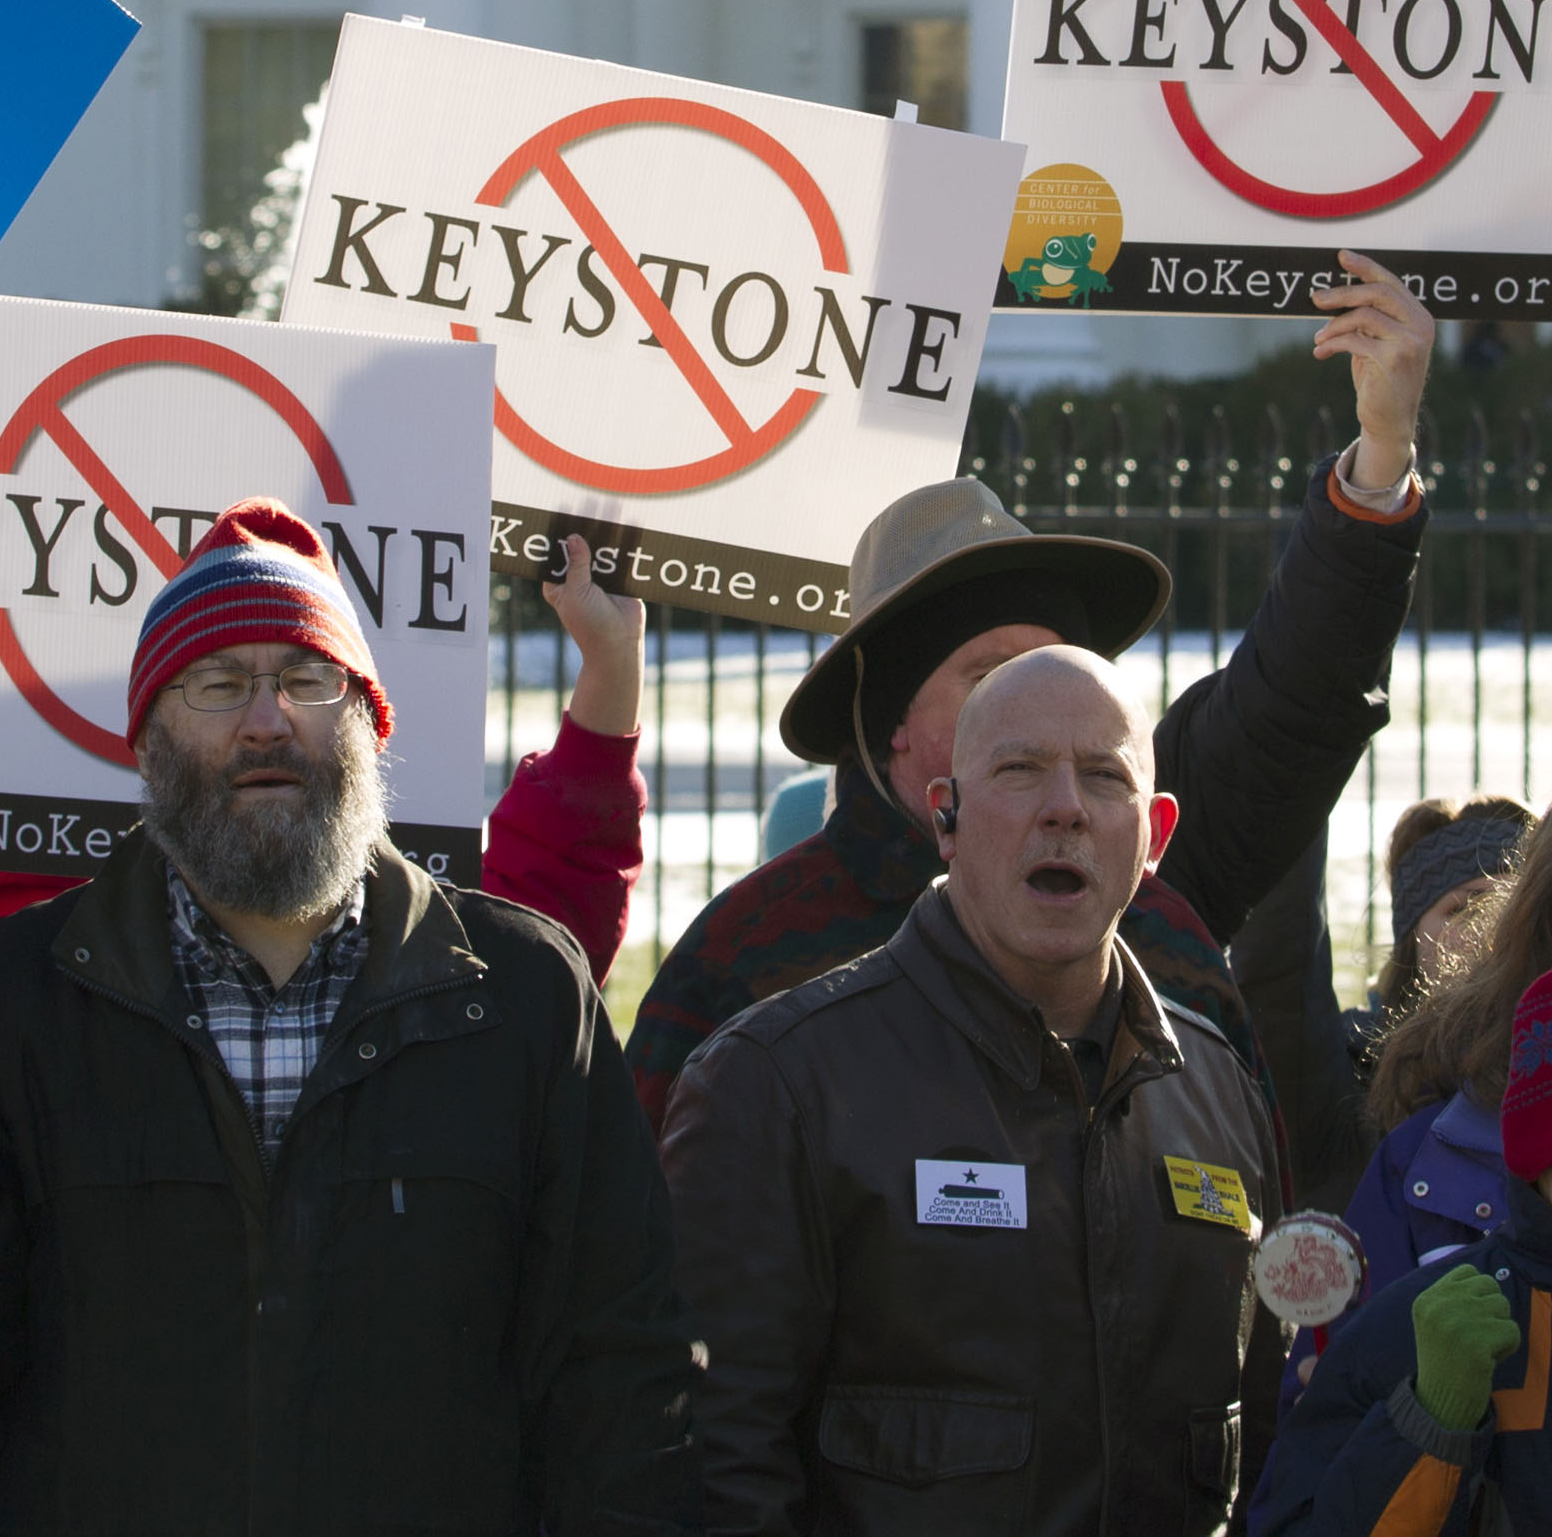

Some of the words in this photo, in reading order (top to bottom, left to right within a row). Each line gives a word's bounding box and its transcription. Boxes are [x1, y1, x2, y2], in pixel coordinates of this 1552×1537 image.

[1030, 183, 1079, 194] CENTER
[1083, 184, 1100, 195] for
[1029, 198, 1098, 210] BIOLOGICAL
[1027, 213, 1097, 226] DIVERSITY
[314, 193, 962, 403] KEYSTONE
[933, 1197, 961, 1207] Come
[983, 1200, 1001, 1209] See
[928, 1205, 956, 1215] Come
[958, 1207, 977, 1216] And
[979, 1208, 1003, 1217] Drink
[924, 1213, 952, 1222] Come
[954, 1214, 973, 1223] And
[975, 1216, 1011, 1225] Breathe
